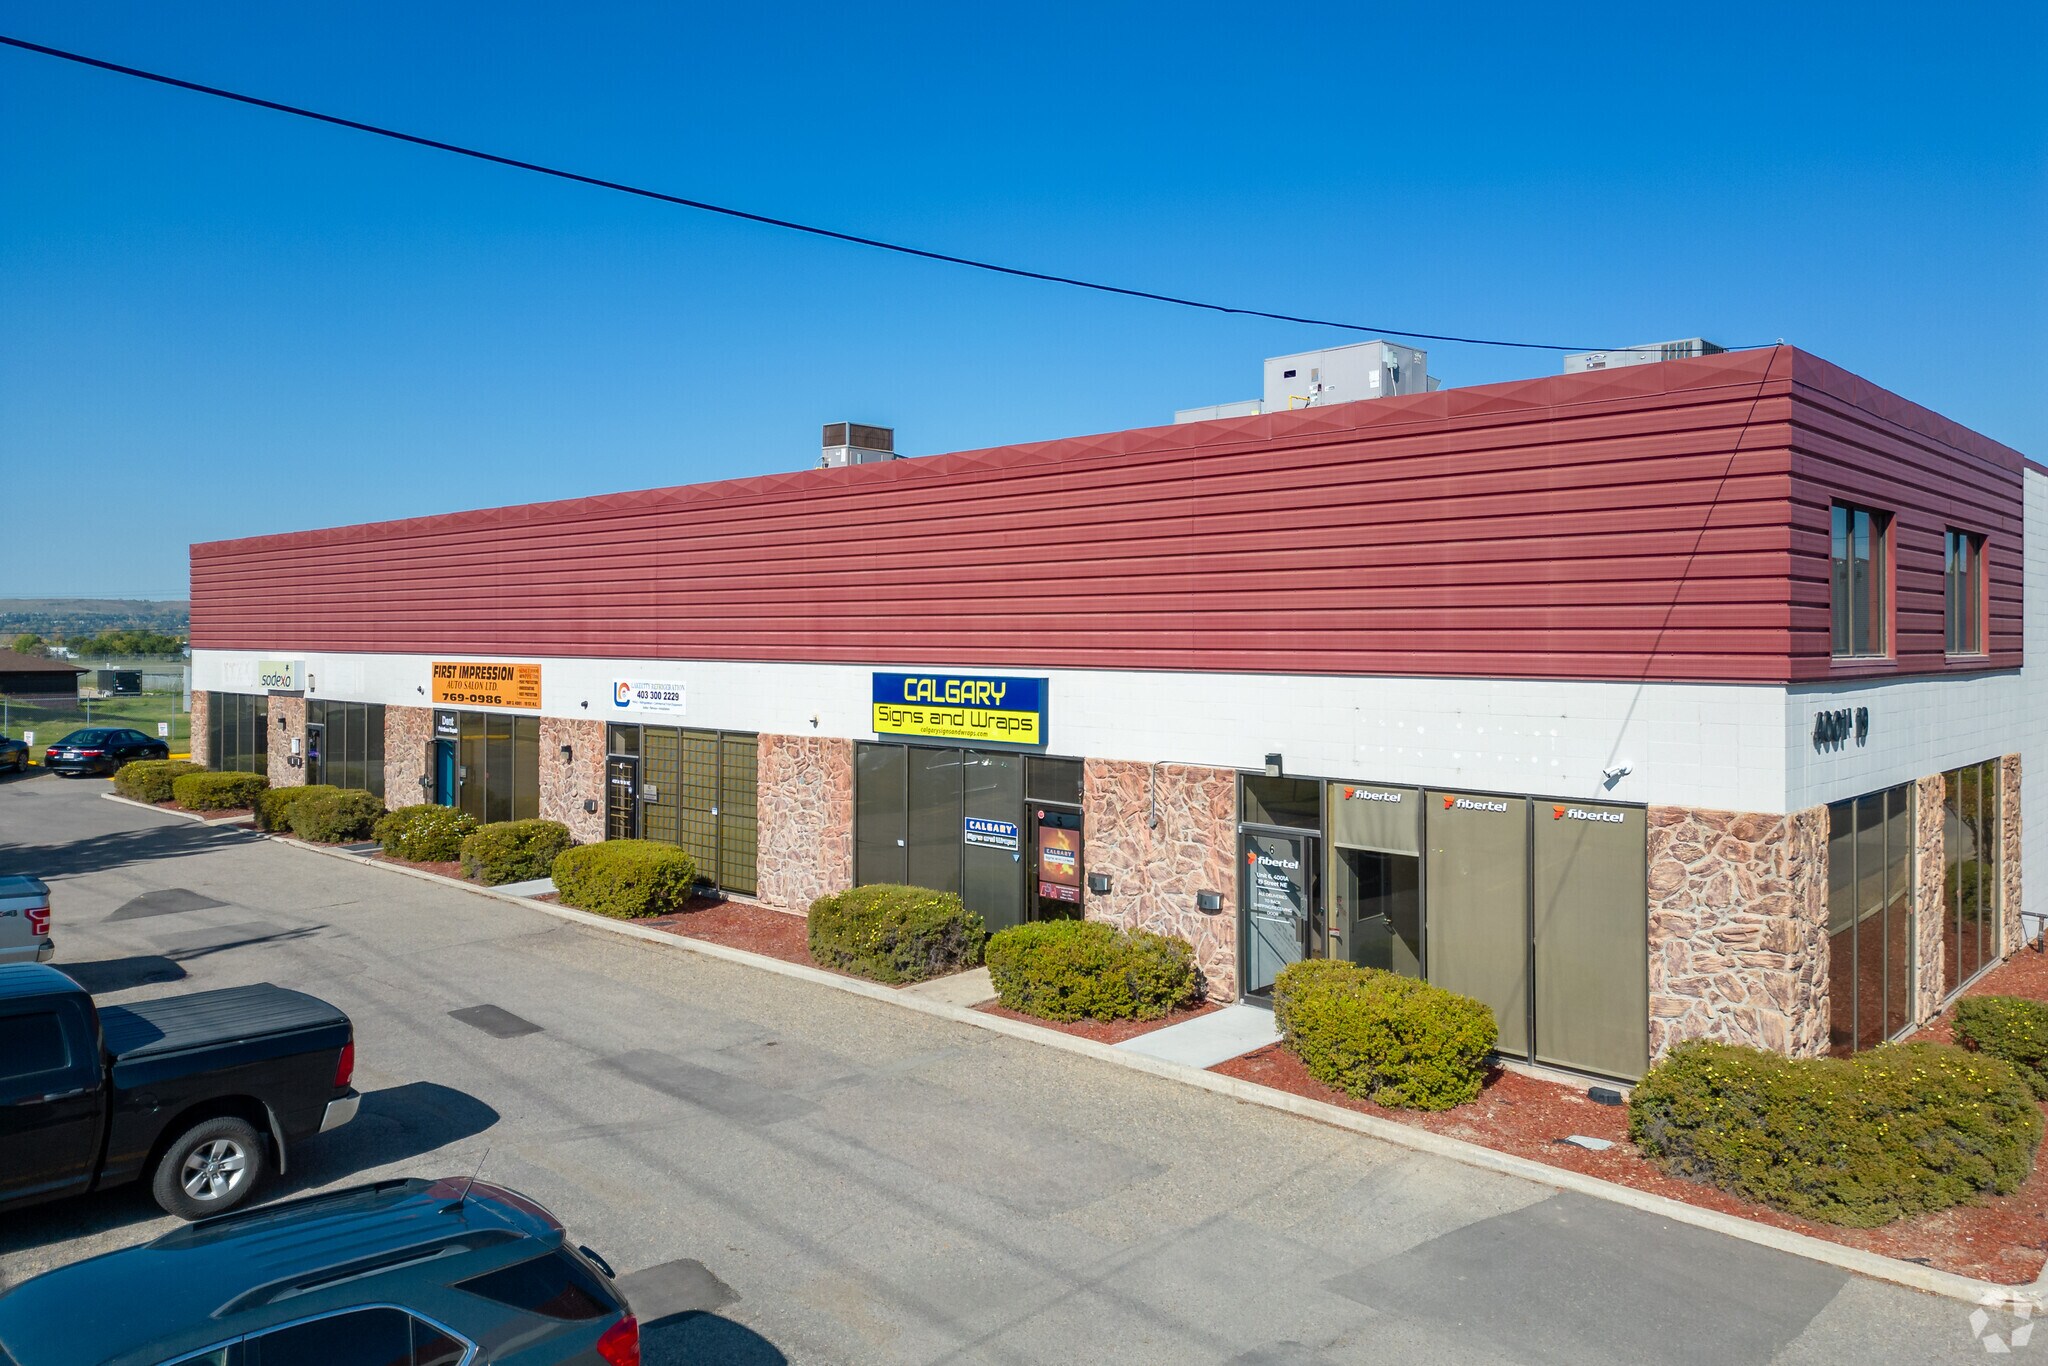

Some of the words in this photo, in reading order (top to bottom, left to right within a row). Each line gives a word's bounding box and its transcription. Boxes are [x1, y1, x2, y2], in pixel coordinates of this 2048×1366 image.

[261, 671, 291, 688] sodexo
[433, 665, 457, 679] FIRST
[459, 665, 514, 681] IMPRESSION
[446, 681, 462, 690] AUTO
[464, 681, 483, 691] SALON
[485, 682, 498, 691] LTD.
[904, 678, 1006, 706] CALGARY
[442, 693, 502, 704] 769-0986
[637, 690, 648, 699] 403
[650, 691, 661, 700] 300
[664, 692, 679, 701] 2229
[878, 706, 923, 727] Signs
[930, 710, 965, 727] and
[971, 711, 1033, 735] Wraps
[920, 727, 989, 738] calgarysignsandwraps.com
[1355, 789, 1402, 803] fibertel
[1455, 798, 1507, 813] fibertel
[1057, 817, 1062, 826] 5
[1567, 808, 1624, 823] fibertel
[969, 820, 1012, 834] CALGARY
[1046, 848, 1072, 857] CALGARY
[1269, 844, 1275, 855] 6
[1257, 856, 1299, 869] fibertel
[1264, 879, 1279, 887] Street
